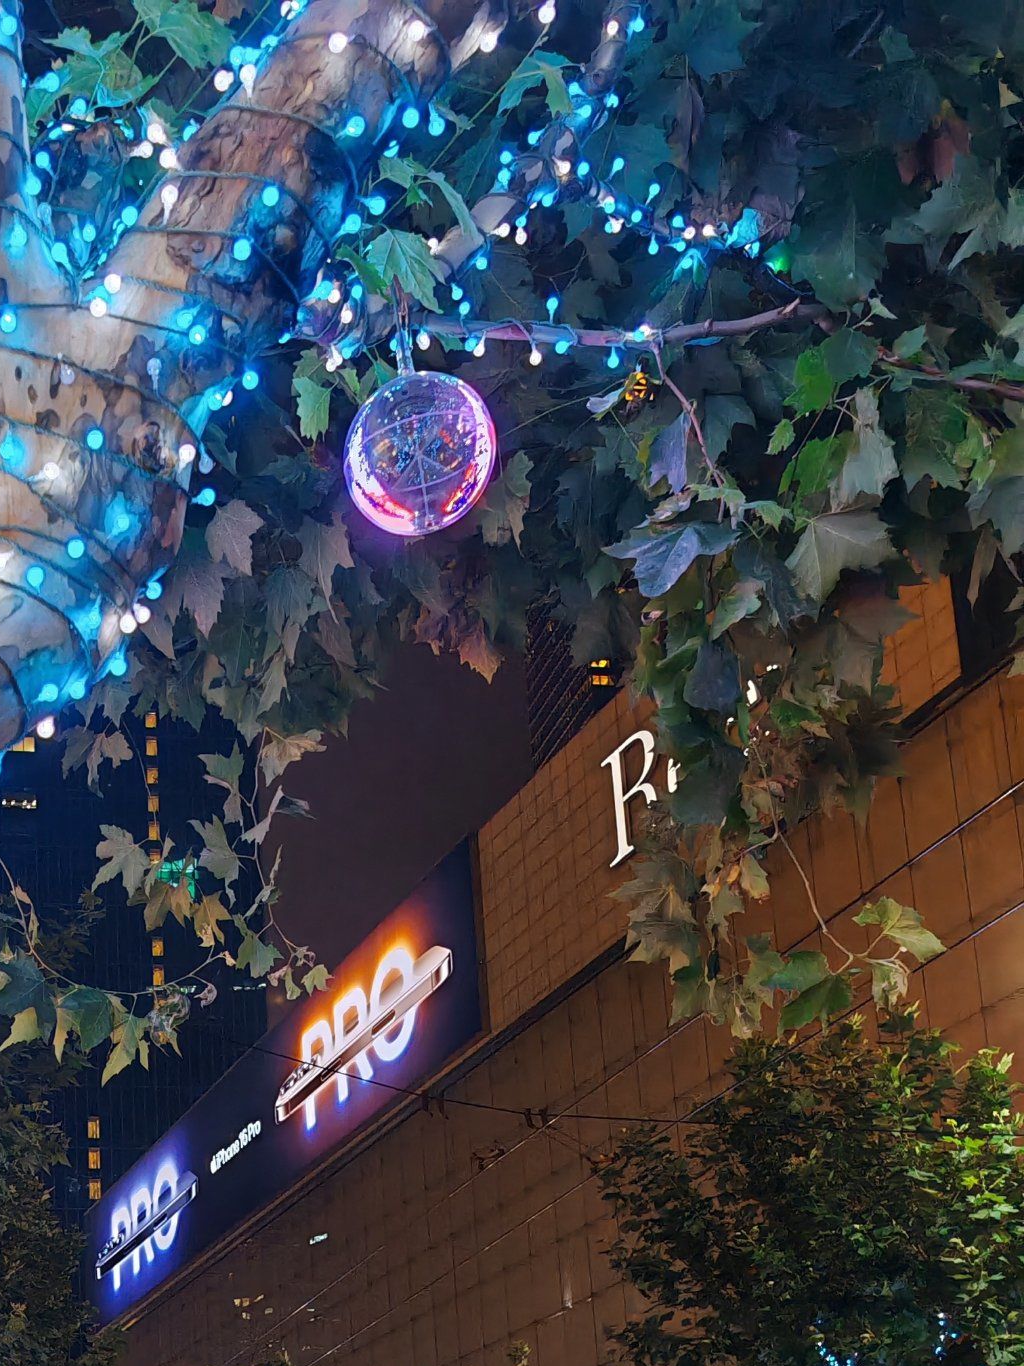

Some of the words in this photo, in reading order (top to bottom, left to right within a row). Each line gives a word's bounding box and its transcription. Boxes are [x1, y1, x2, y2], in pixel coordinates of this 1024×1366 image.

[301, 947, 417, 1130] PRO
[215, 1139, 240, 1170] iPhone
[247, 1120, 261, 1142] Pro
[111, 1162, 179, 1291] PRO
